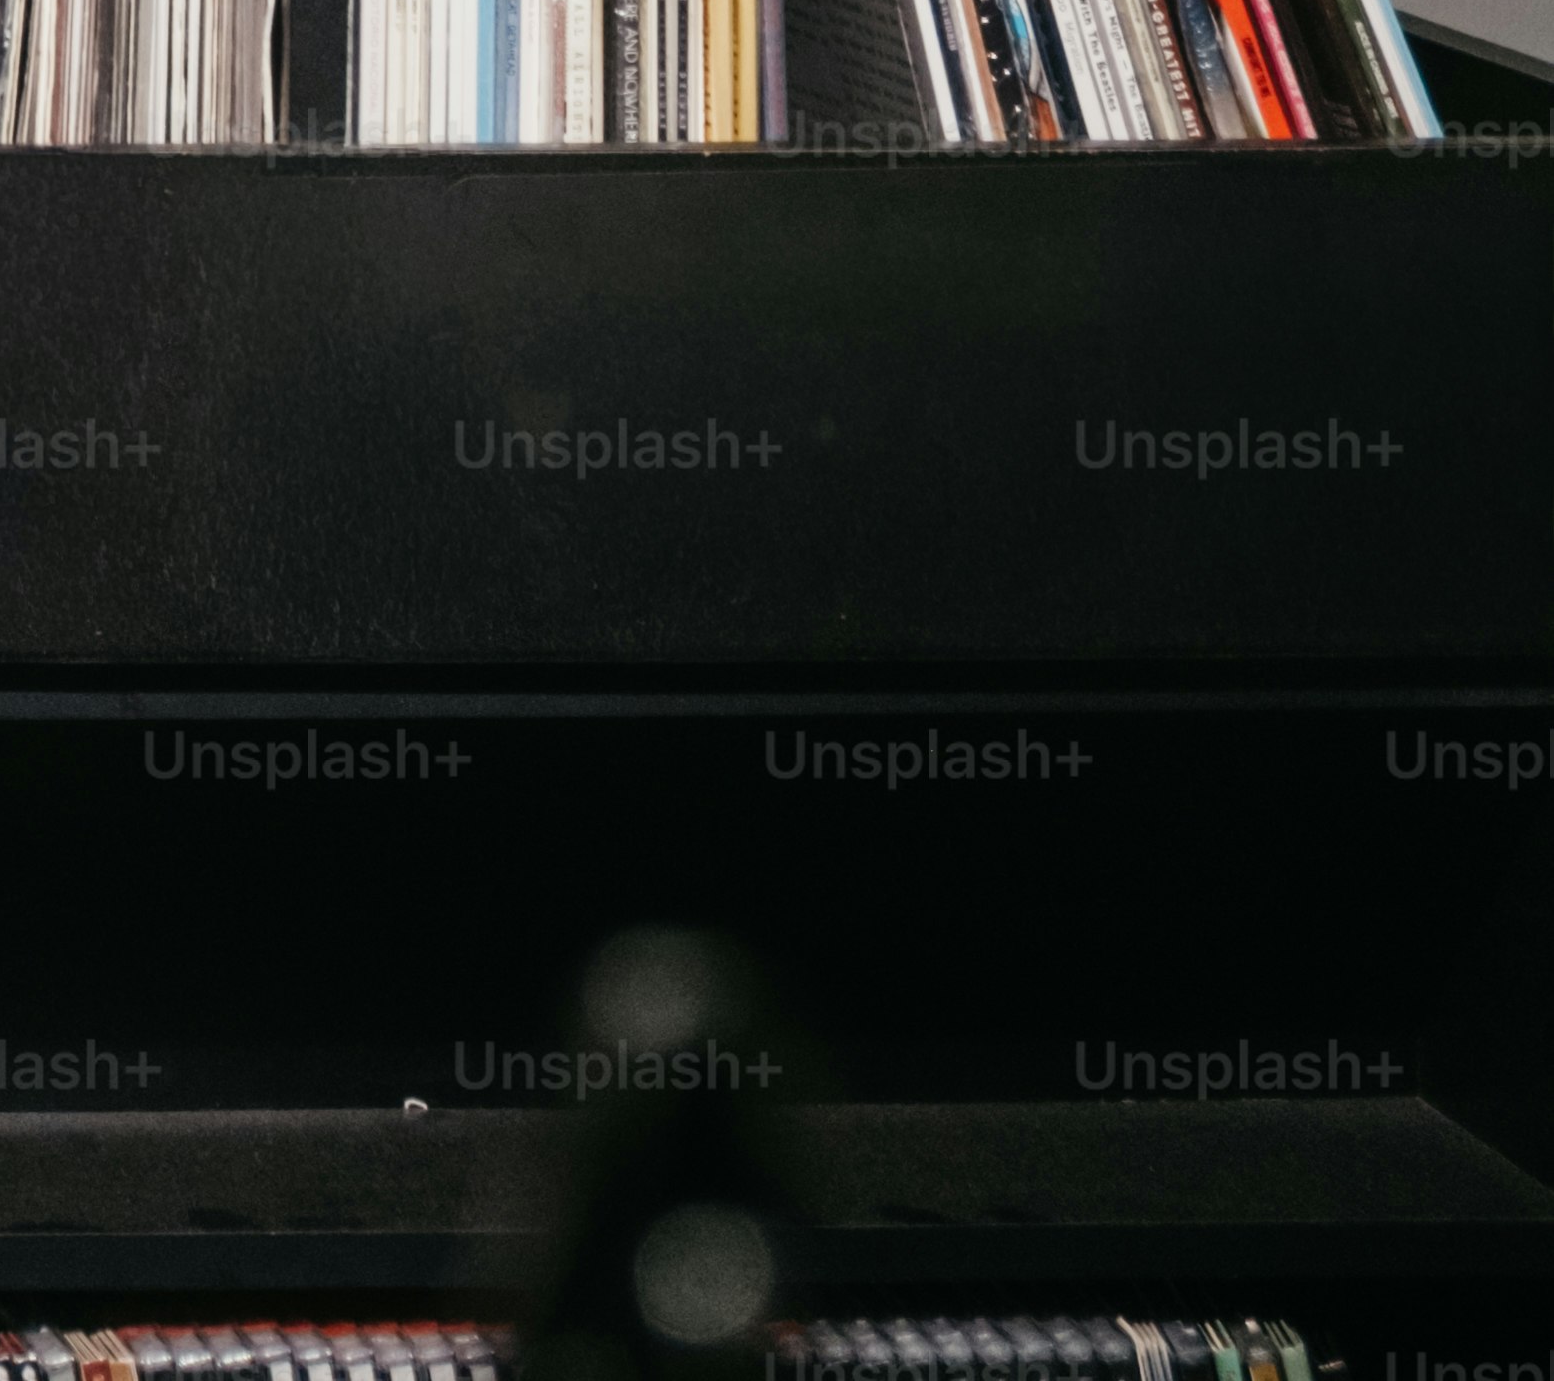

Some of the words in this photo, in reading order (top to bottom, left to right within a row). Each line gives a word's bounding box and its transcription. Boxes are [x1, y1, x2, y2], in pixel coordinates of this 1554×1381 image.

[573, 3, 585, 36] ALL
[624, 27, 637, 62] AND
[1059, 20, 1087, 76] Migration
[1087, 29, 1103, 56] The
[1095, 60, 1119, 113] Beatles
[1105, 14, 1126, 52] Night
[1125, 75, 1140, 98] The
